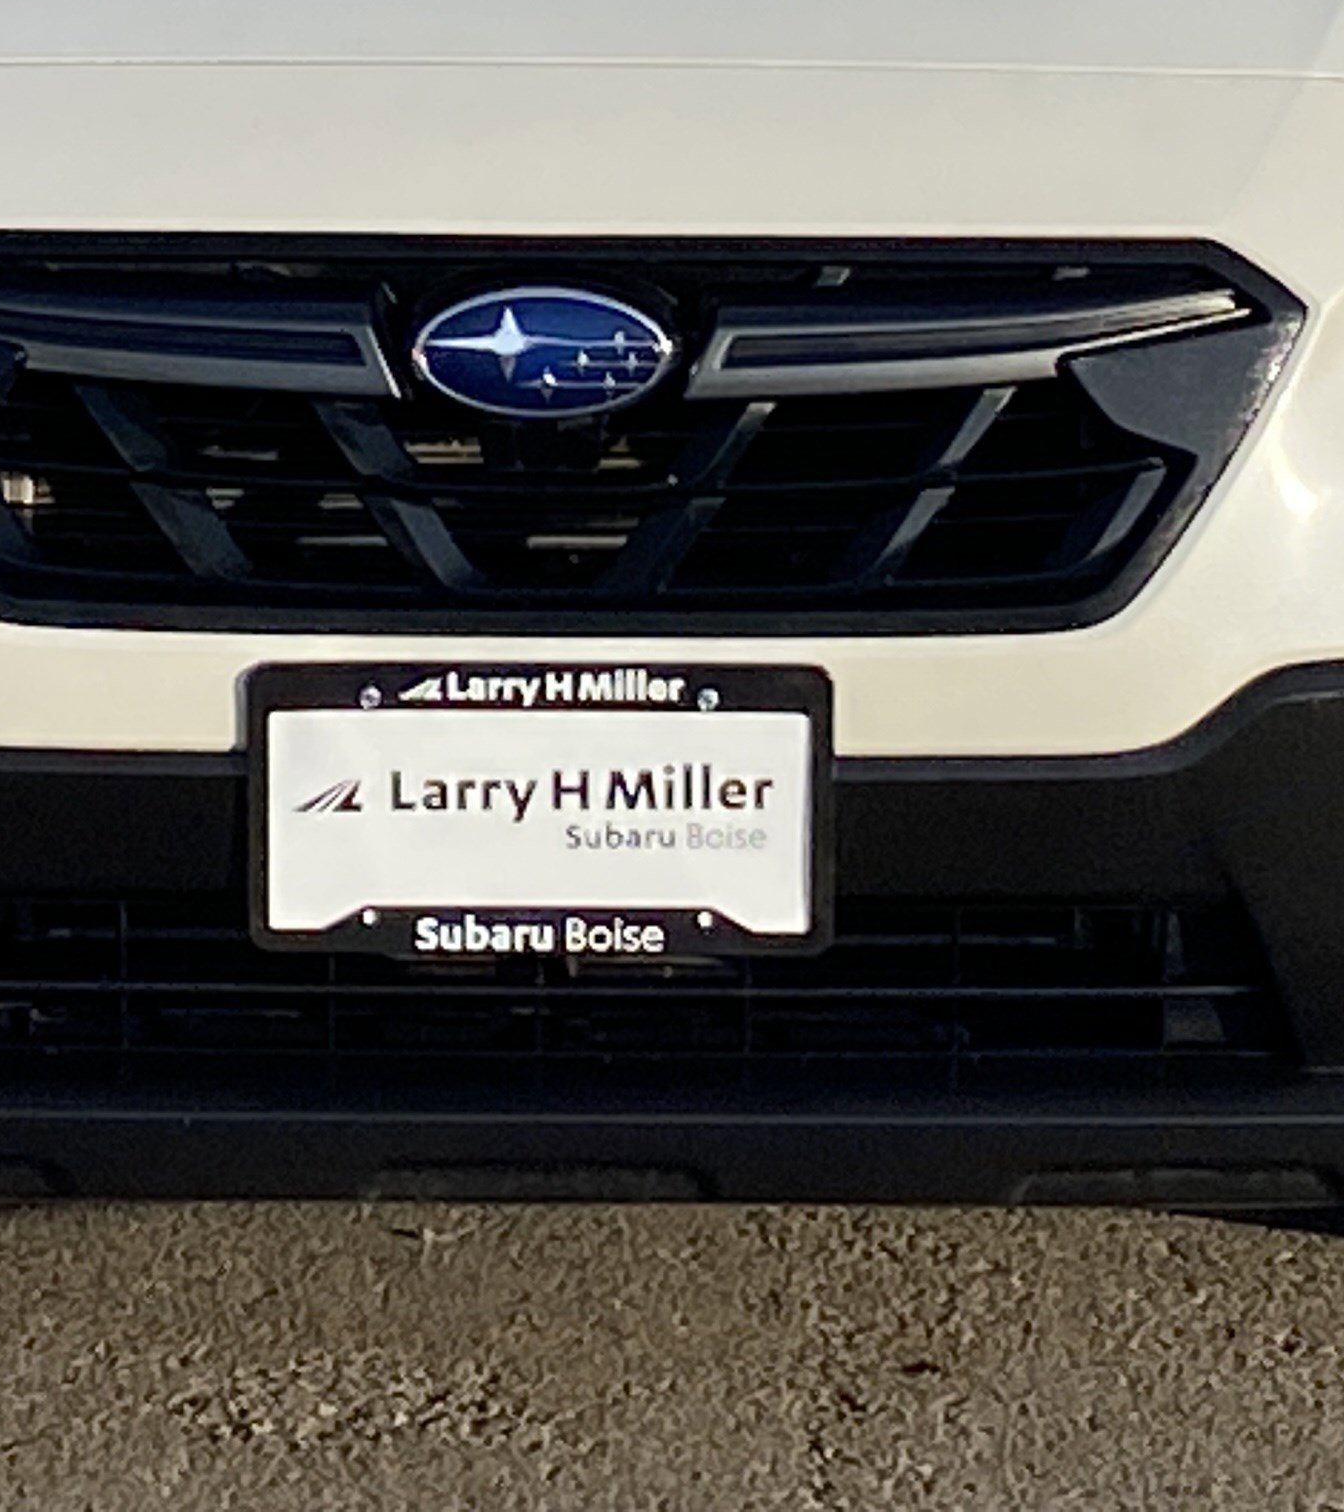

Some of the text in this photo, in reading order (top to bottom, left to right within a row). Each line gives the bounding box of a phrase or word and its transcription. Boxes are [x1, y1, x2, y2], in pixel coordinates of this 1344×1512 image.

[446, 668, 686, 707] Larry H Miller
[390, 763, 774, 822] Larry H Miller
[565, 823, 768, 850] Subaru Boise
[414, 916, 666, 952] Subaru Boise
